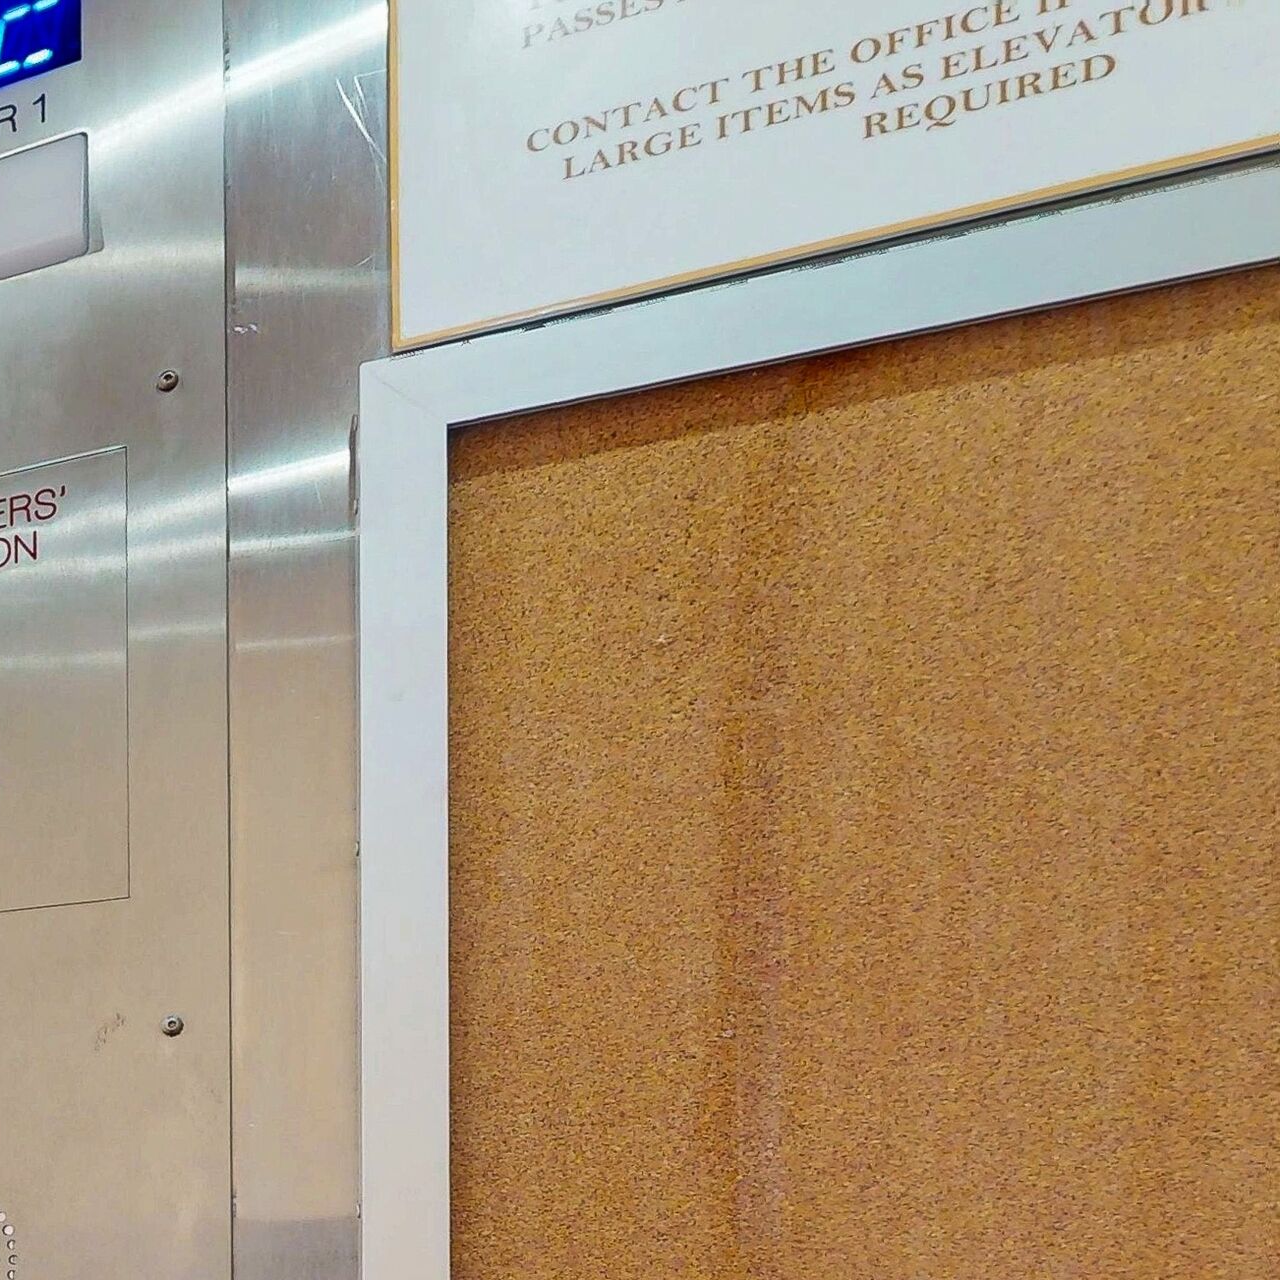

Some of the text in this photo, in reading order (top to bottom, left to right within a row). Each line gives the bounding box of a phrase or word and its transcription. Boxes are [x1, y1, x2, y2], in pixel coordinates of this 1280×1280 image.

[33, 93, 47, 124] 1
[526, 0, 1019, 153] CONTACT THE OFFICE
[562, 123, 702, 180] LARGE
[716, 81, 856, 140] ITEMS
[870, 63, 925, 98] AS
[862, 53, 1117, 140] REQUIRED
